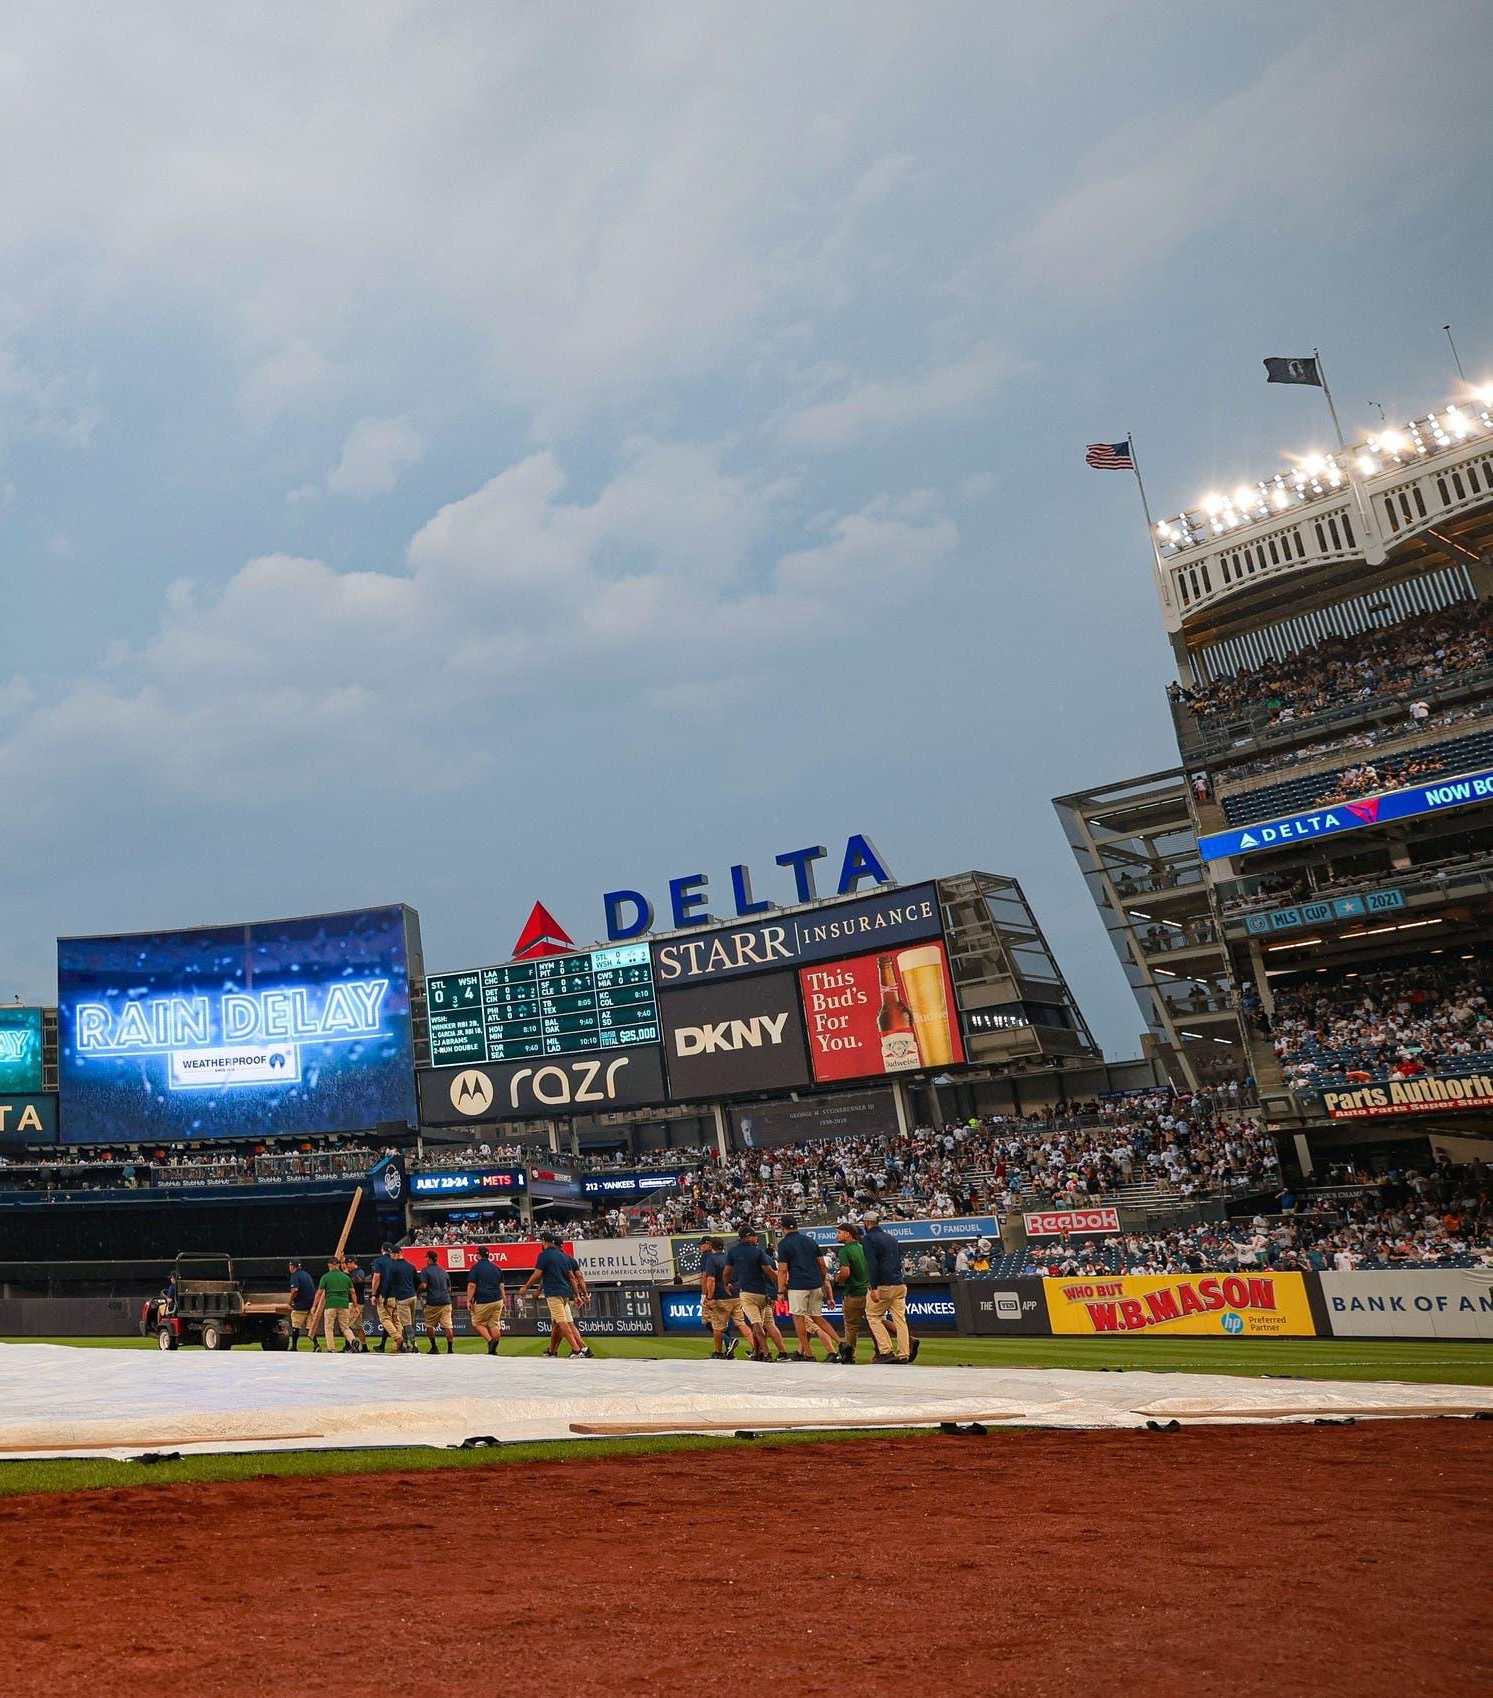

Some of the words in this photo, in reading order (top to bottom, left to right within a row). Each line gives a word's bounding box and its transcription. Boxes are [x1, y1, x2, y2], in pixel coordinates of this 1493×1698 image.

[1425, 782, 1471, 806] NOW
[1261, 814, 1340, 842] DELTA
[603, 834, 898, 942] DELTA
[1274, 912, 1297, 929] MLS
[1306, 906, 1328, 921] CUP
[1372, 893, 1400, 908] 2021
[659, 925, 795, 980] STARR
[804, 901, 933, 944] INSURANCE
[539, 962, 555, 970] NYM
[596, 960, 612, 968] WSH
[484, 970, 498, 978] LAA
[597, 972, 613, 980] CWS
[807, 969, 854, 993] This
[431, 981, 446, 990] STL
[458, 977, 478, 986] WSH
[541, 981, 549, 989] SF
[598, 980, 611, 988] MIA
[435, 990, 444, 1003] 0
[464, 986, 474, 999] 4
[541, 988, 554, 996] CLE
[811, 987, 868, 1012] Bud's
[76, 996, 210, 1050] RAIN
[221, 979, 389, 1043] DELAY
[488, 1014, 500, 1022] ATL
[489, 1025, 503, 1033] HOU
[814, 1011, 849, 1033] For
[580, 1037, 597, 1045] 10:10
[620, 1027, 656, 1043] $25,000
[674, 1012, 789, 1057] DKNY
[454, 1044, 478, 1052] DOUBLE
[547, 1044, 561, 1053] LAD
[602, 1038, 619, 1046] TOTAL
[815, 1031, 863, 1053] You.
[181, 1055, 267, 1069] WEATHERPROOF
[510, 1057, 629, 1107] razr
[1324, 1087, 1388, 1111] Parts
[1335, 1108, 1367, 1118] Auto
[1369, 1104, 1408, 1114] Parts
[1410, 1101, 1455, 1111] Super
[416, 1178, 440, 1189] JULY
[483, 1174, 511, 1186] METS
[585, 1181, 598, 1191] 212
[603, 1180, 635, 1190] YANKEES
[943, 1224, 982, 1233] FANDUEL
[1027, 1211, 1118, 1235] Reebok
[578, 1256, 637, 1267] MERRILL
[1063, 1284, 1094, 1300] WHO
[1097, 1282, 1124, 1297] BUT
[670, 1303, 692, 1317] JULY
[906, 1302, 955, 1315] YANKEES
[980, 1301, 993, 1311] THE
[1022, 1301, 1037, 1310] APP
[1332, 1296, 1406, 1312] BANK
[1414, 1296, 1448, 1312] OF
[578, 1320, 614, 1332] StubHub
[616, 1320, 653, 1332] StubHub
[1224, 1314, 1240, 1333] hp
[1248, 1315, 1287, 1324] Preferred
[1250, 1323, 1280, 1332] Partner
